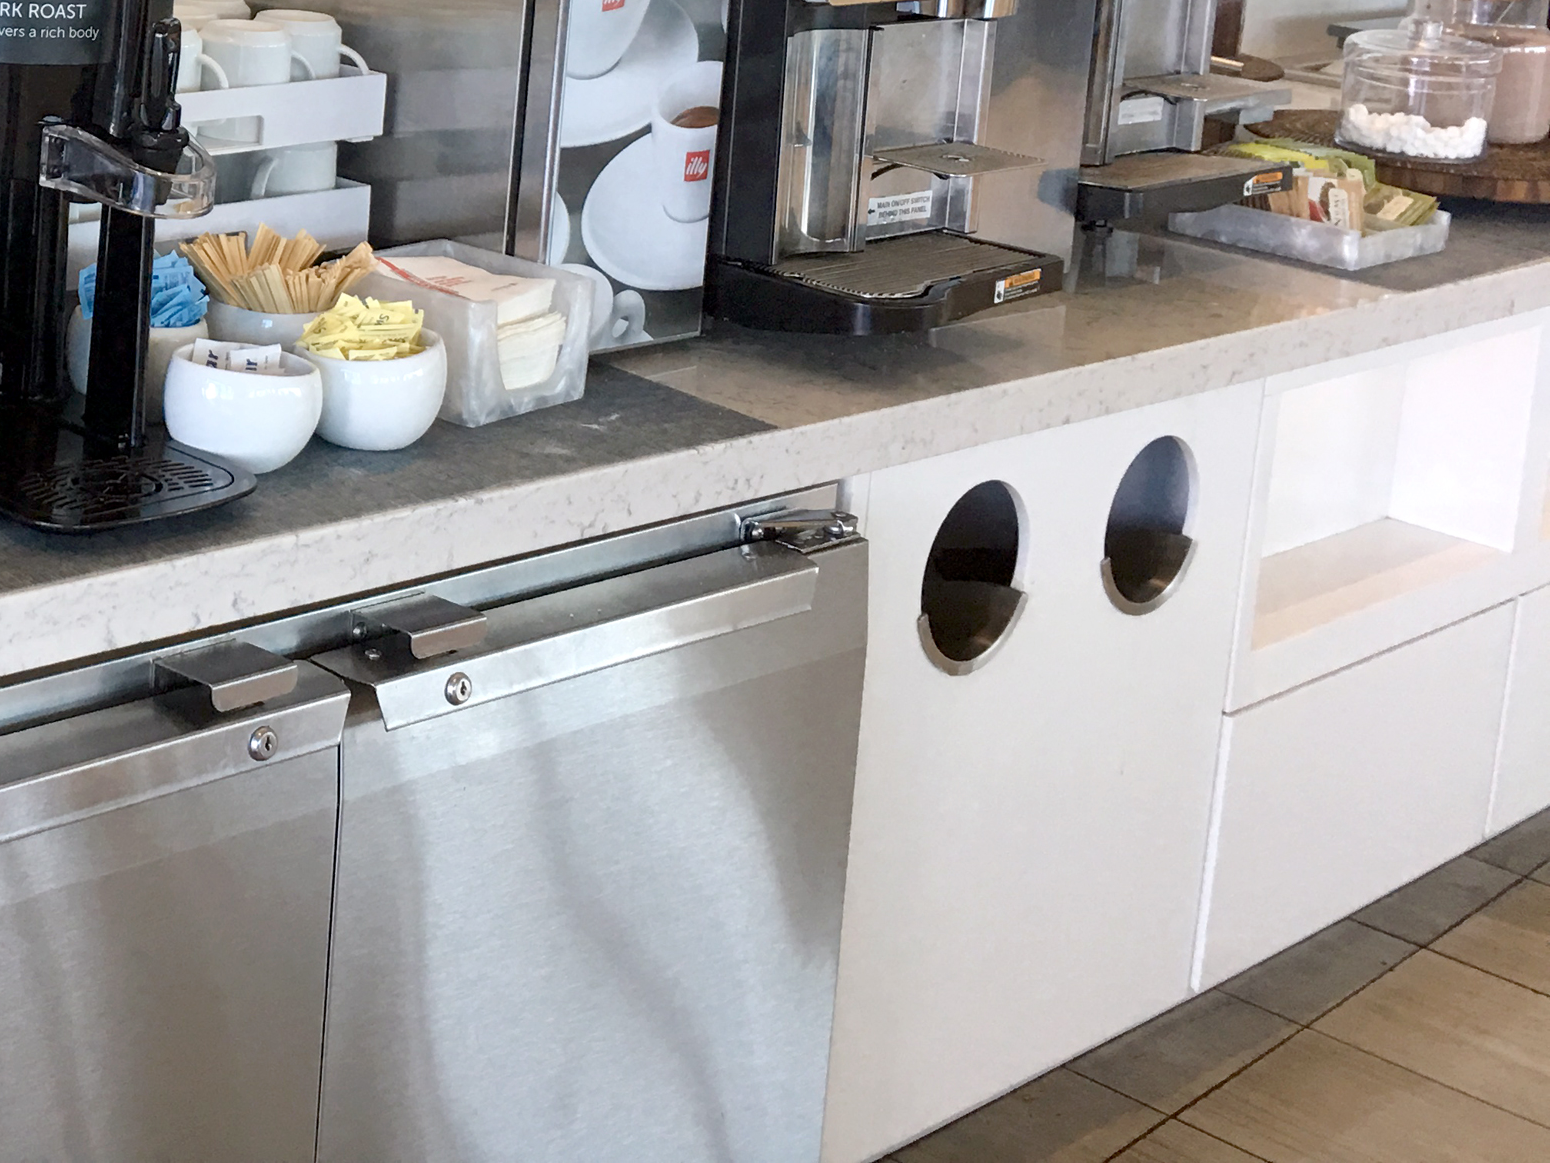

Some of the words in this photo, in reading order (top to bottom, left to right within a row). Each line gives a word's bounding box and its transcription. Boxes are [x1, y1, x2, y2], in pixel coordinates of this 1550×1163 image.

[28, 3, 87, 19] ROAST
[28, 29, 36, 38] a
[40, 26, 65, 38] rich
[69, 26, 99, 41] body
[686, 156, 707, 179] illy
